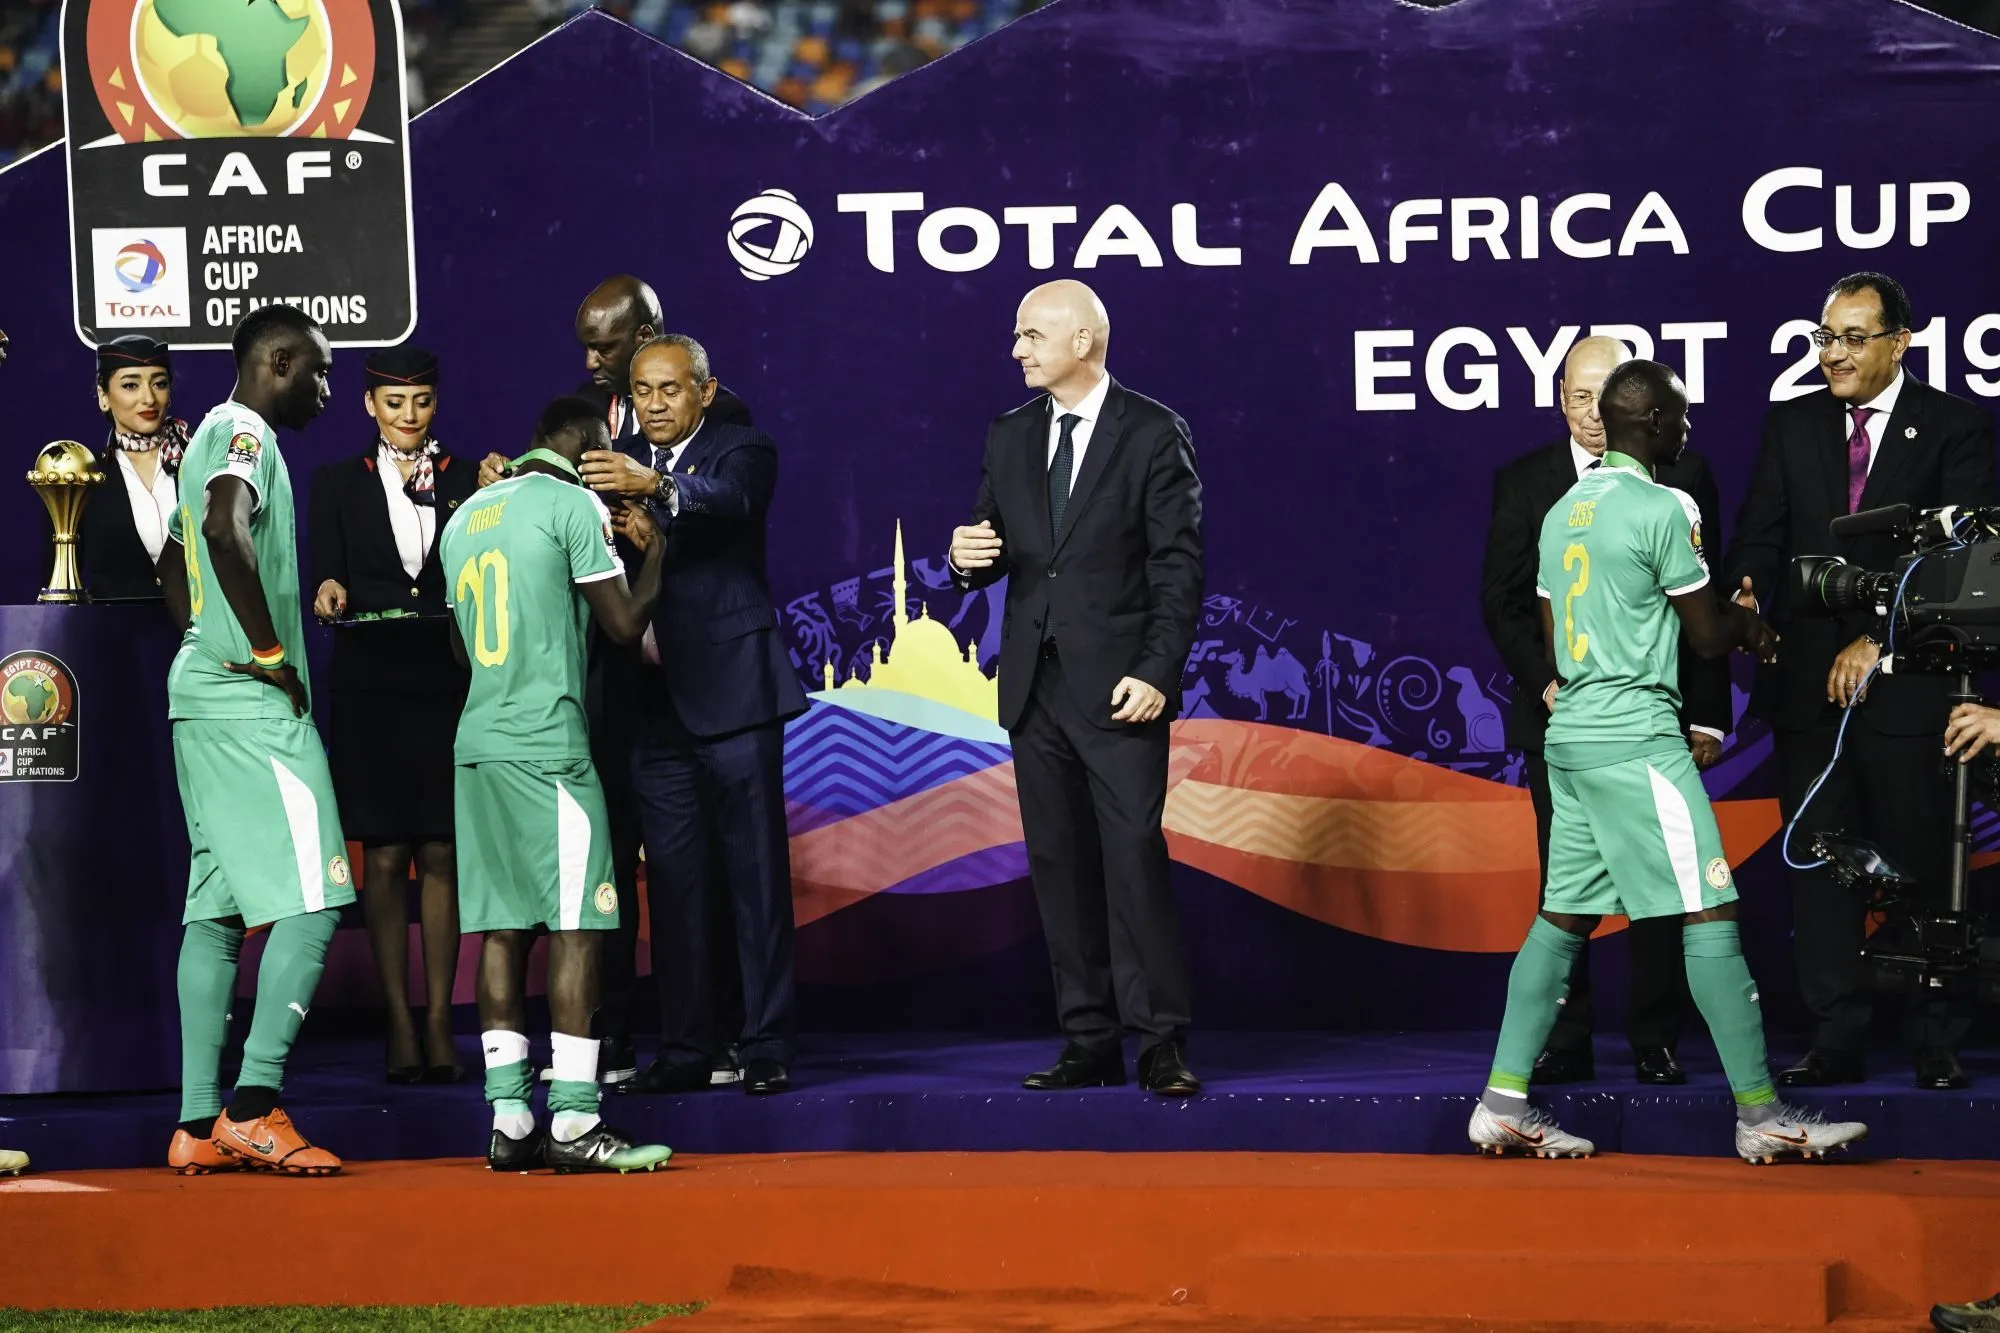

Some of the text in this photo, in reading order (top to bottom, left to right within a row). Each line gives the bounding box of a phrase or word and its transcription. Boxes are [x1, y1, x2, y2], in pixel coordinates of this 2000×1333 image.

[837, 166, 1971, 273] TOTAL AFRICA CUP
[203, 225, 304, 255] AFRICA
[205, 262, 259, 291] CUP
[105, 302, 181, 317] TOTAL
[206, 298, 241, 327] OF
[1769, 313, 2000, 402] 219
[456, 548, 509, 667] 10
[1563, 542, 1590, 663] 2
[3, 659, 58, 678] EGYPT 2019
[16, 747, 47, 756] AFRICA
[16, 757, 34, 766] CUP
[16, 767, 28, 776] OF
[29, 767, 65, 776] NATIONS
